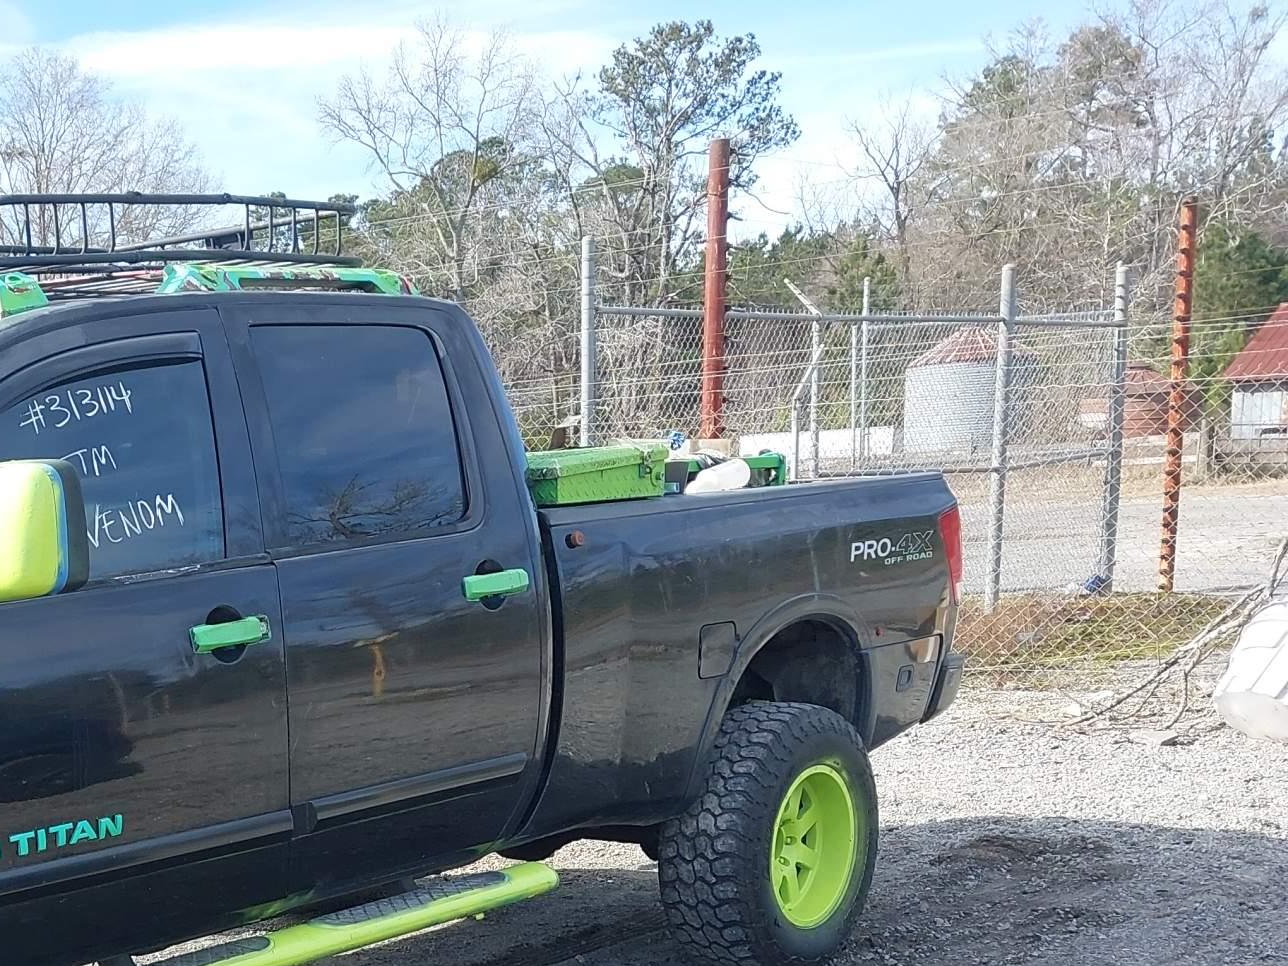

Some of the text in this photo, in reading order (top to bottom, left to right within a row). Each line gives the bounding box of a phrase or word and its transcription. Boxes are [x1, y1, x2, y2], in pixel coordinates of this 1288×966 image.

[19, 381, 132, 435] #313114
[87, 493, 185, 549] VENOM
[884, 551, 933, 566] OFF ROAD
[9, 814, 124, 857] TITAN
